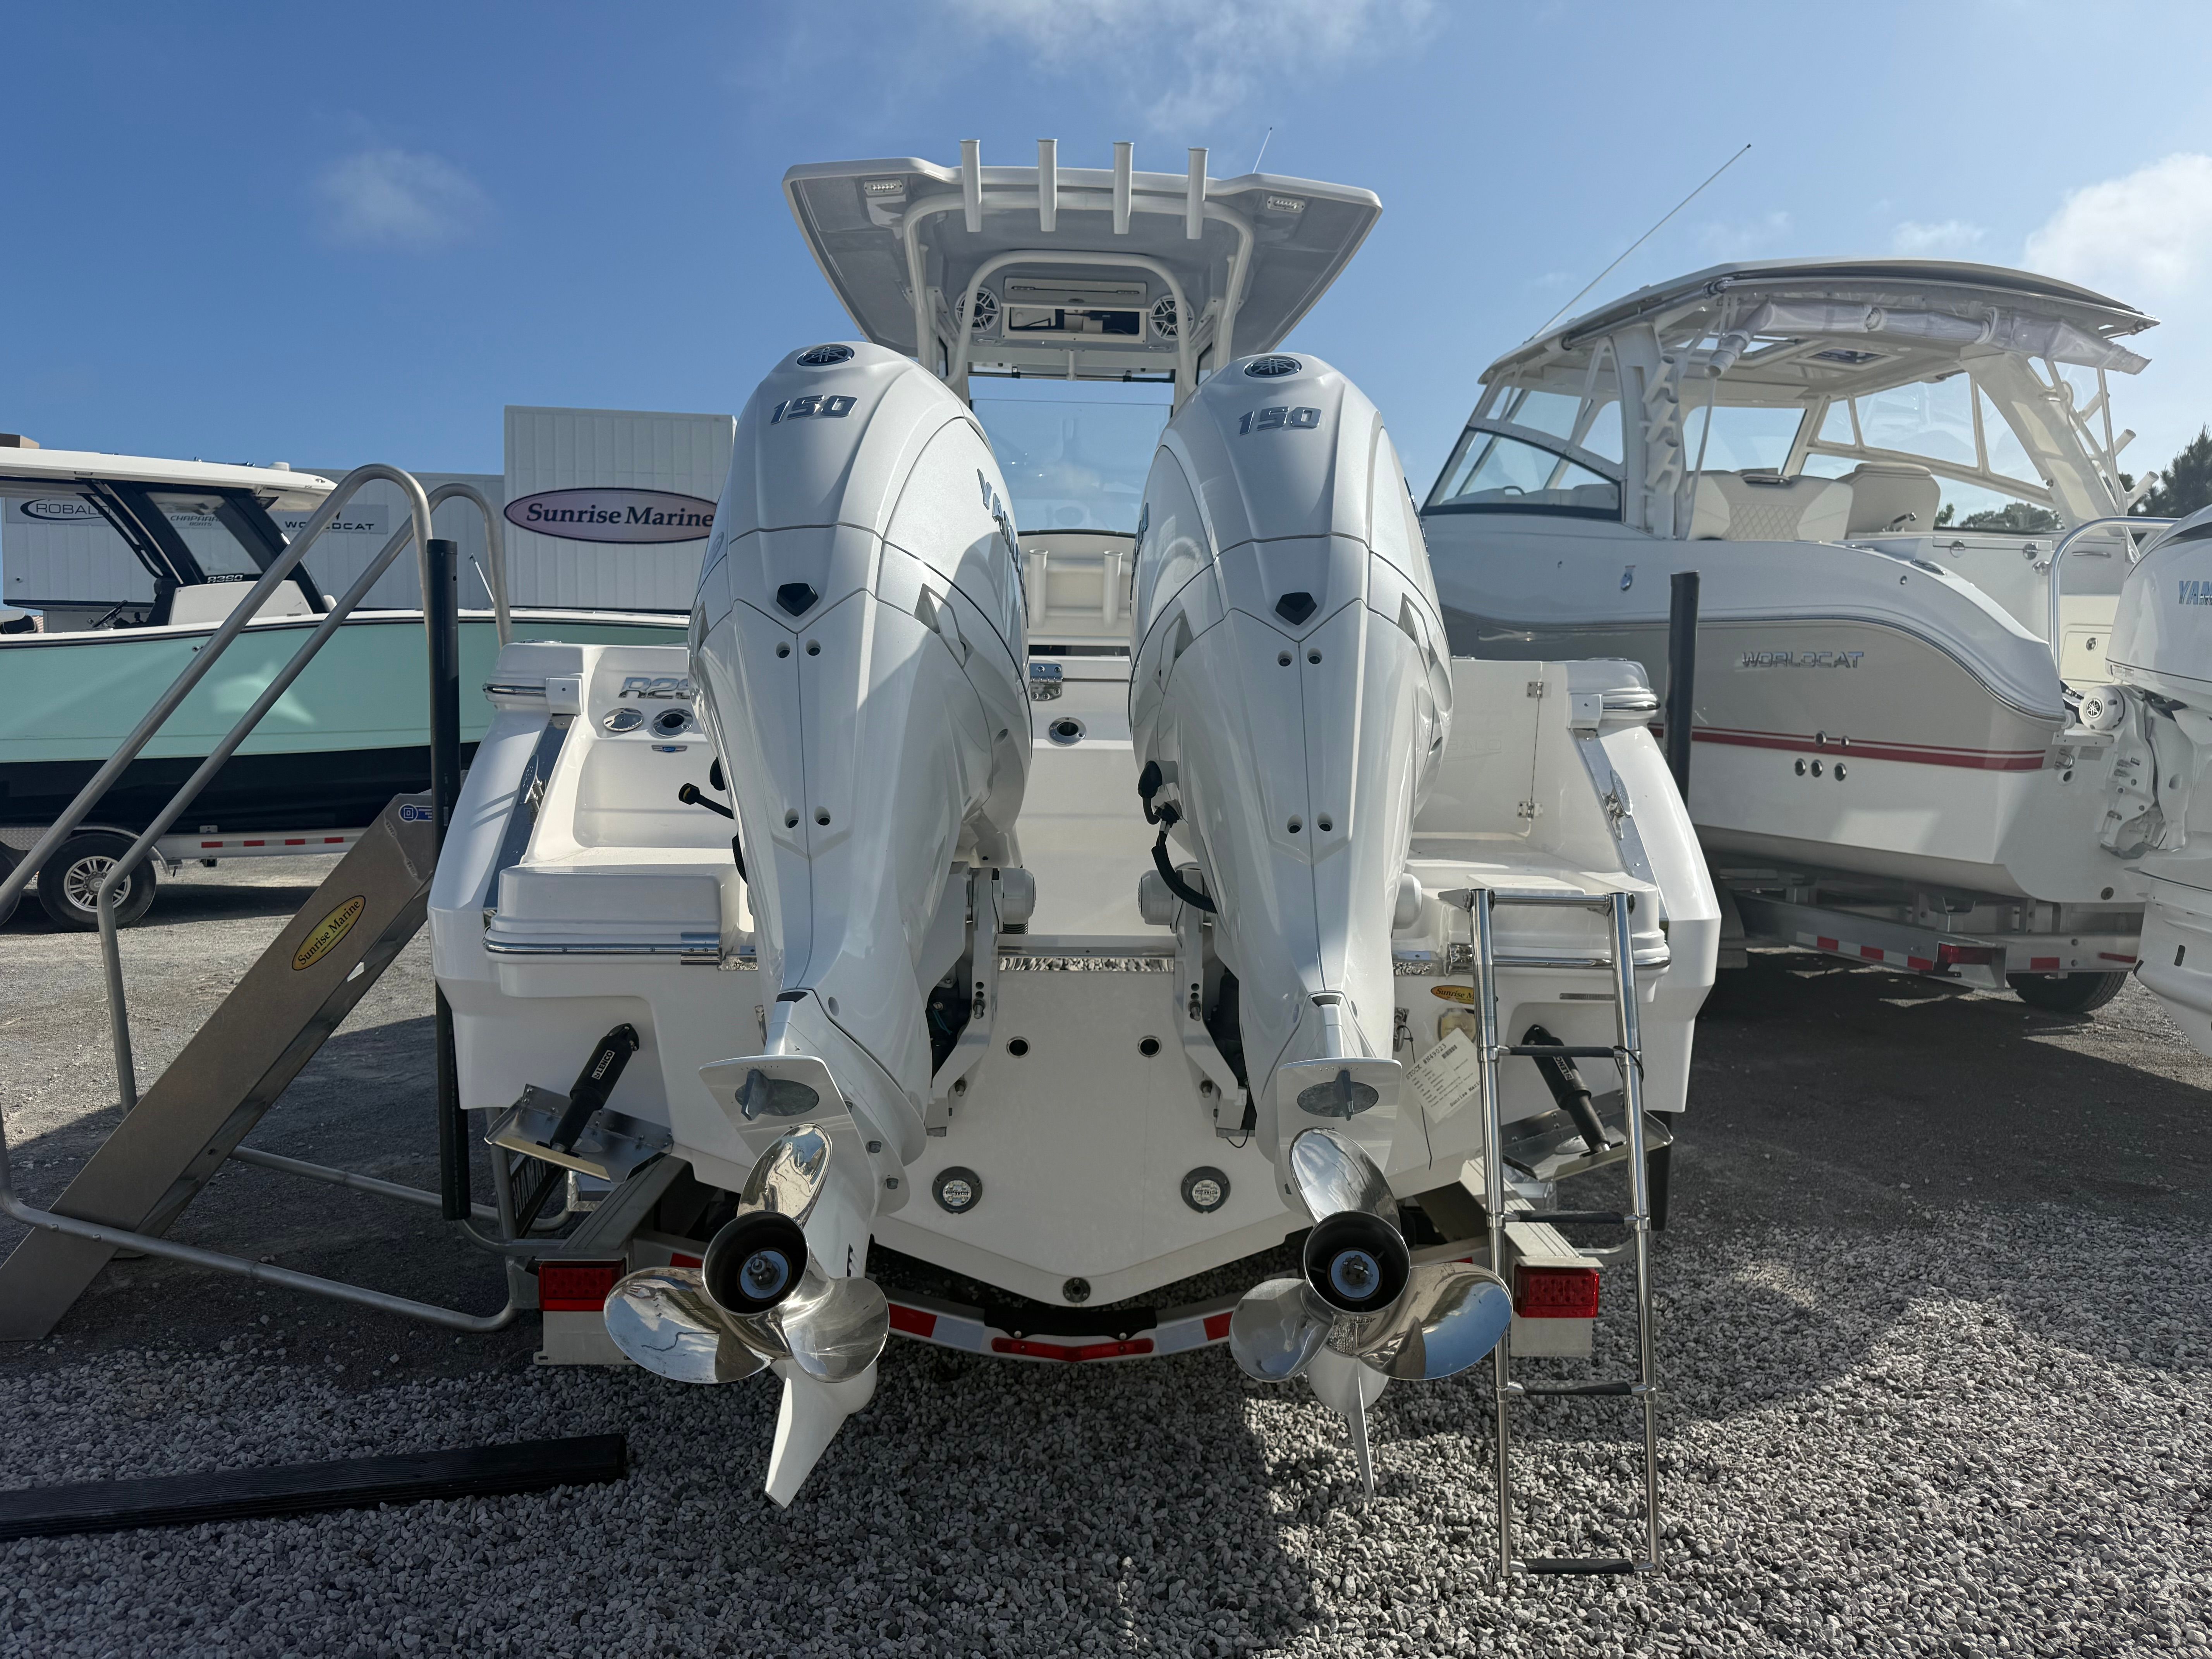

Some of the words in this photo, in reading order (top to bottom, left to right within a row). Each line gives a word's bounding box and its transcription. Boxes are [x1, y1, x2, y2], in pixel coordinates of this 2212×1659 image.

[771, 395, 858, 425] 150
[1239, 406, 1322, 436] 150
[285, 521, 374, 530] WODCAT
[526, 503, 622, 524] Sunrise
[624, 506, 714, 527] Marine
[1742, 651, 1864, 668] WORLDCAT
[298, 932, 331, 965] Sunrise
[328, 901, 360, 934] Marine
[1436, 988, 1465, 998] Sunrise
[596, 1051, 613, 1073] LENCO
[1406, 1064, 1422, 1080] STOCK
[1449, 1091, 1468, 1107] Sunrise
[1468, 1081, 1480, 1092] Mari
